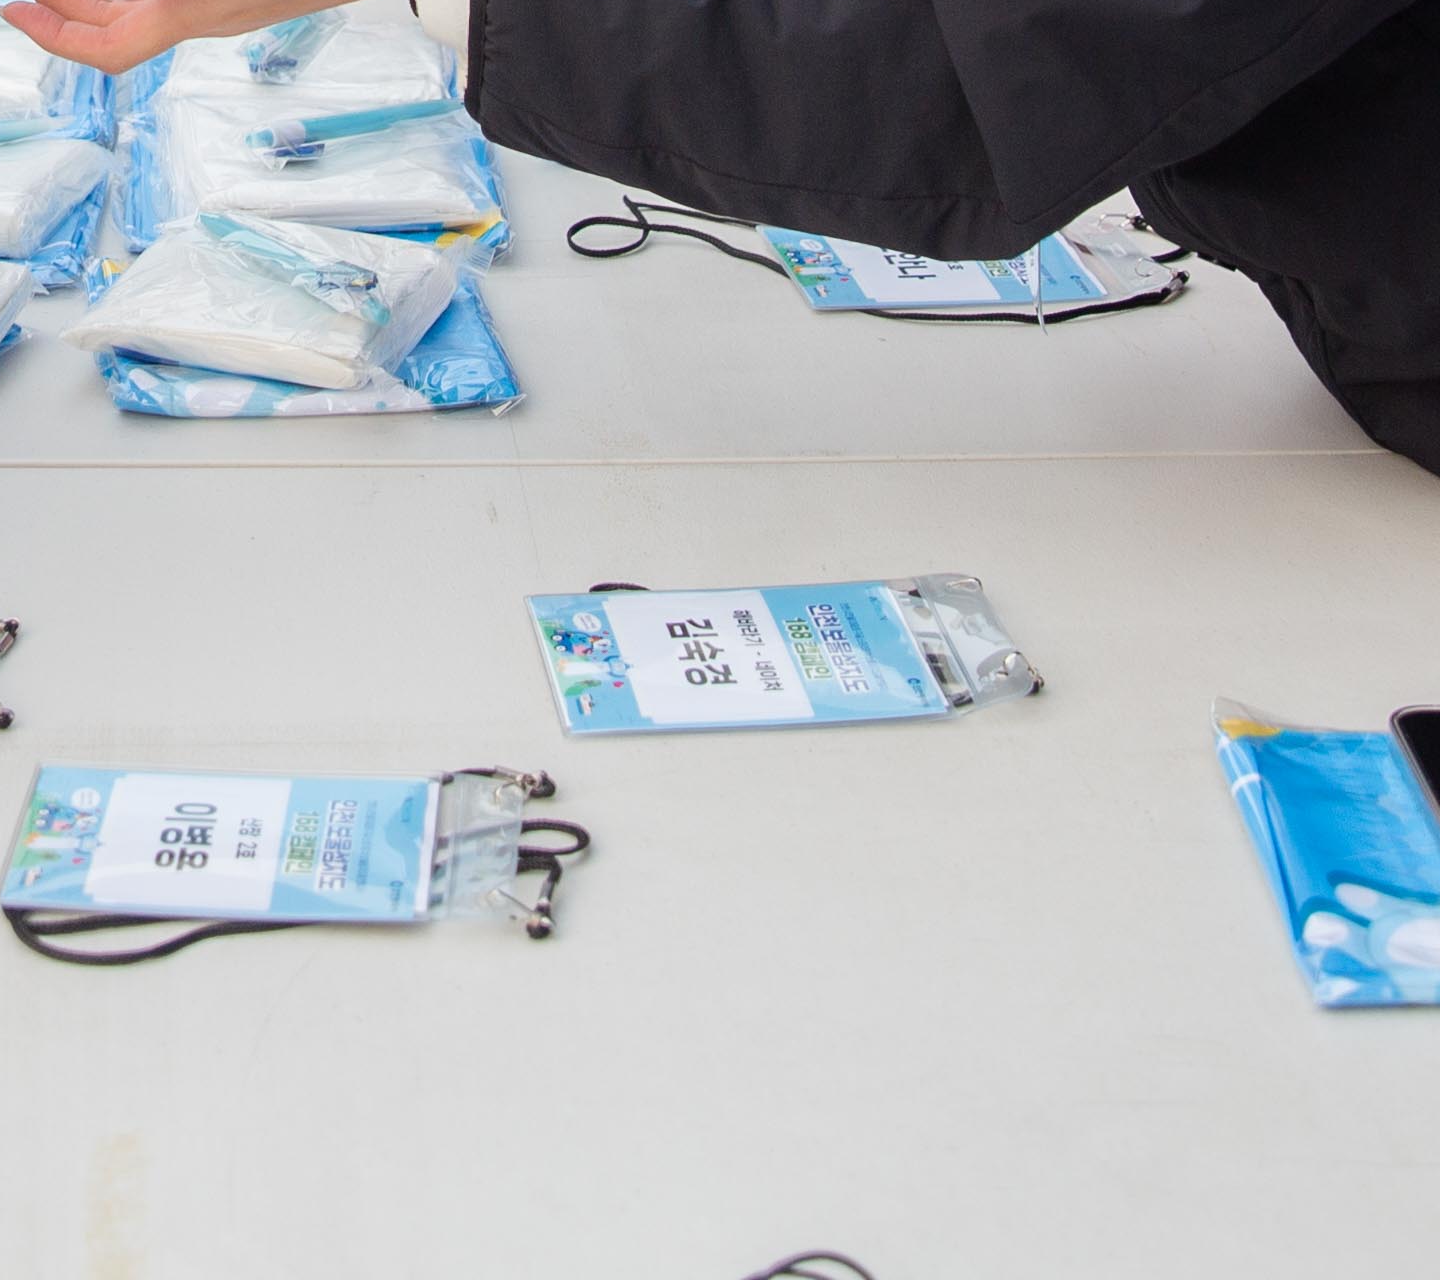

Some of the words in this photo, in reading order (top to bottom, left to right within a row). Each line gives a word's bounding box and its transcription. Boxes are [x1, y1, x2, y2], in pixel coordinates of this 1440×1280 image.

[732, 608, 766, 648] 해바라기
[783, 616, 806, 639] 168
[808, 602, 838, 630] 인천
[665, 617, 739, 687] 김숙경
[235, 840, 259, 860] 2호
